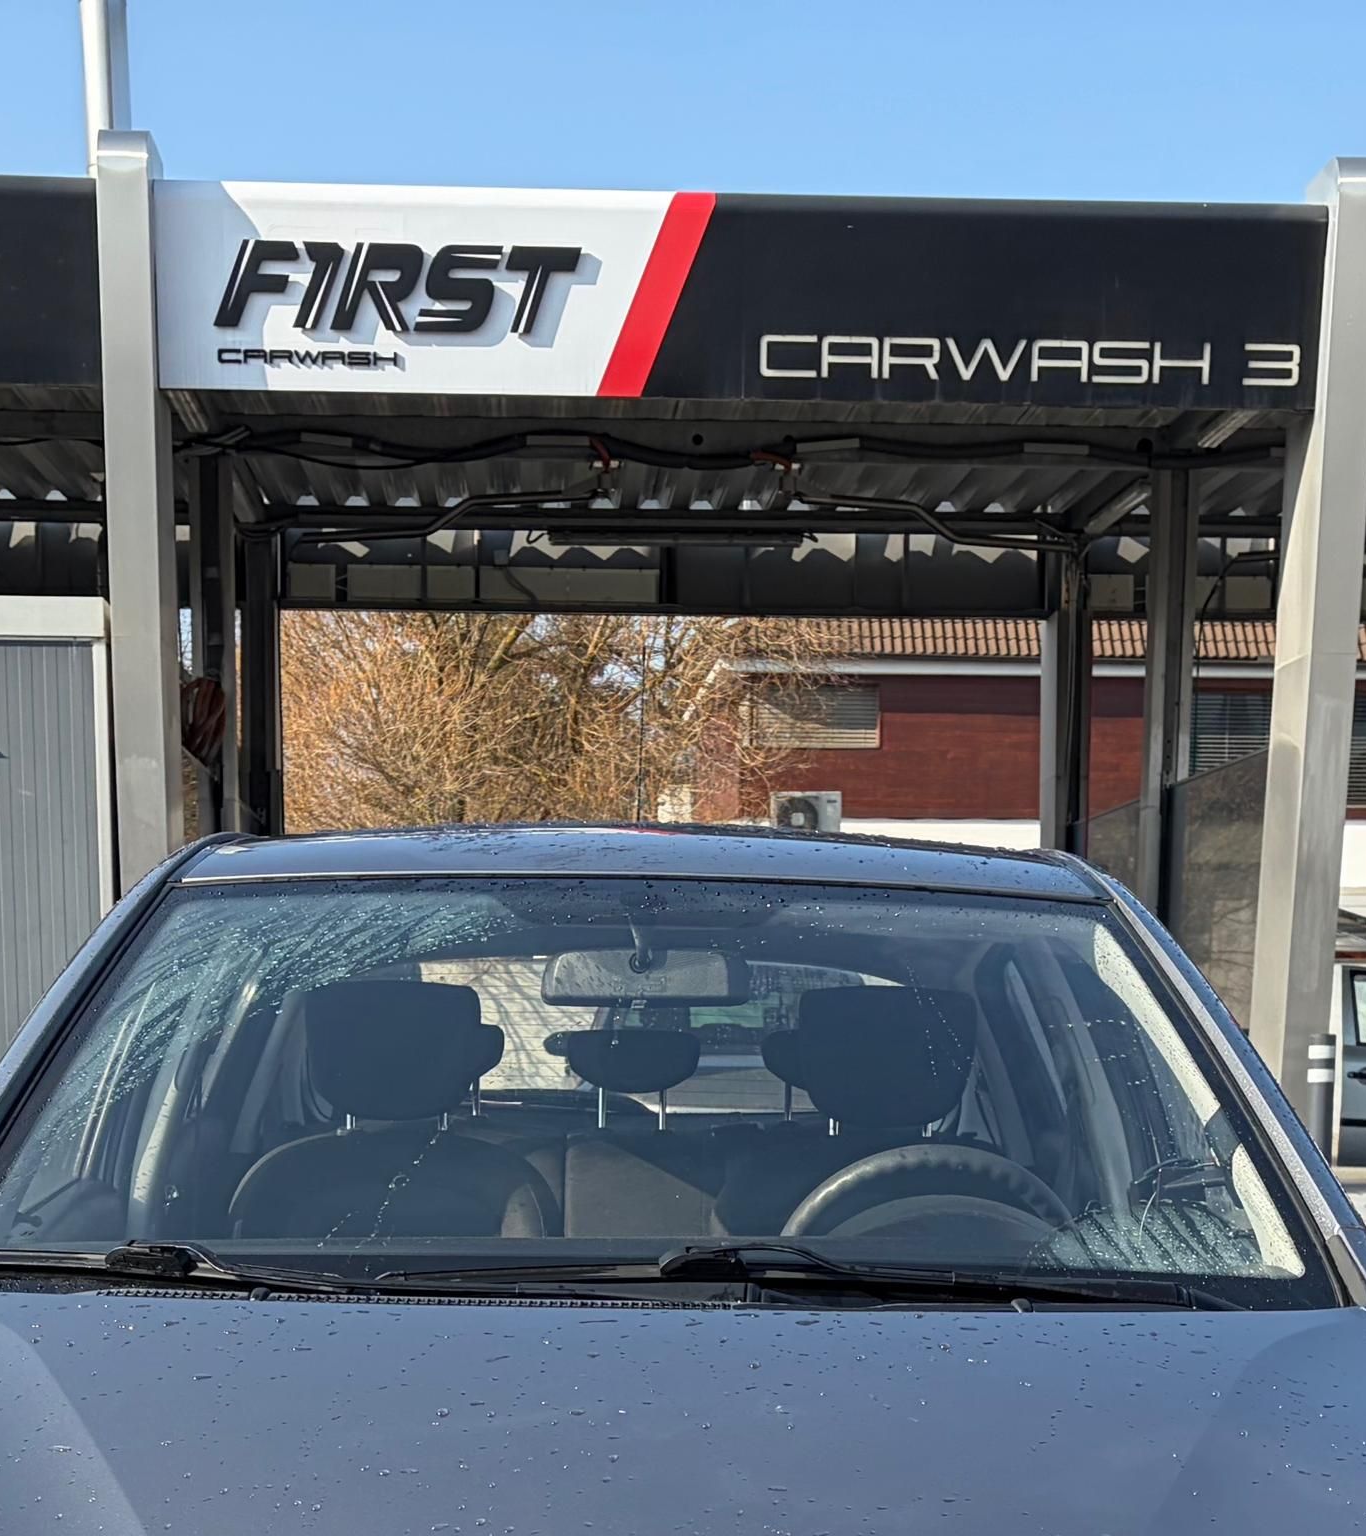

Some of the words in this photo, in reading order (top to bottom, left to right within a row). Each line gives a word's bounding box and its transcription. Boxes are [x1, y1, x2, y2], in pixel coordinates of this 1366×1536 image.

[217, 348, 399, 367] CARWASH
[759, 334, 1210, 385] CARWASH
[1242, 342, 1302, 386] 3
